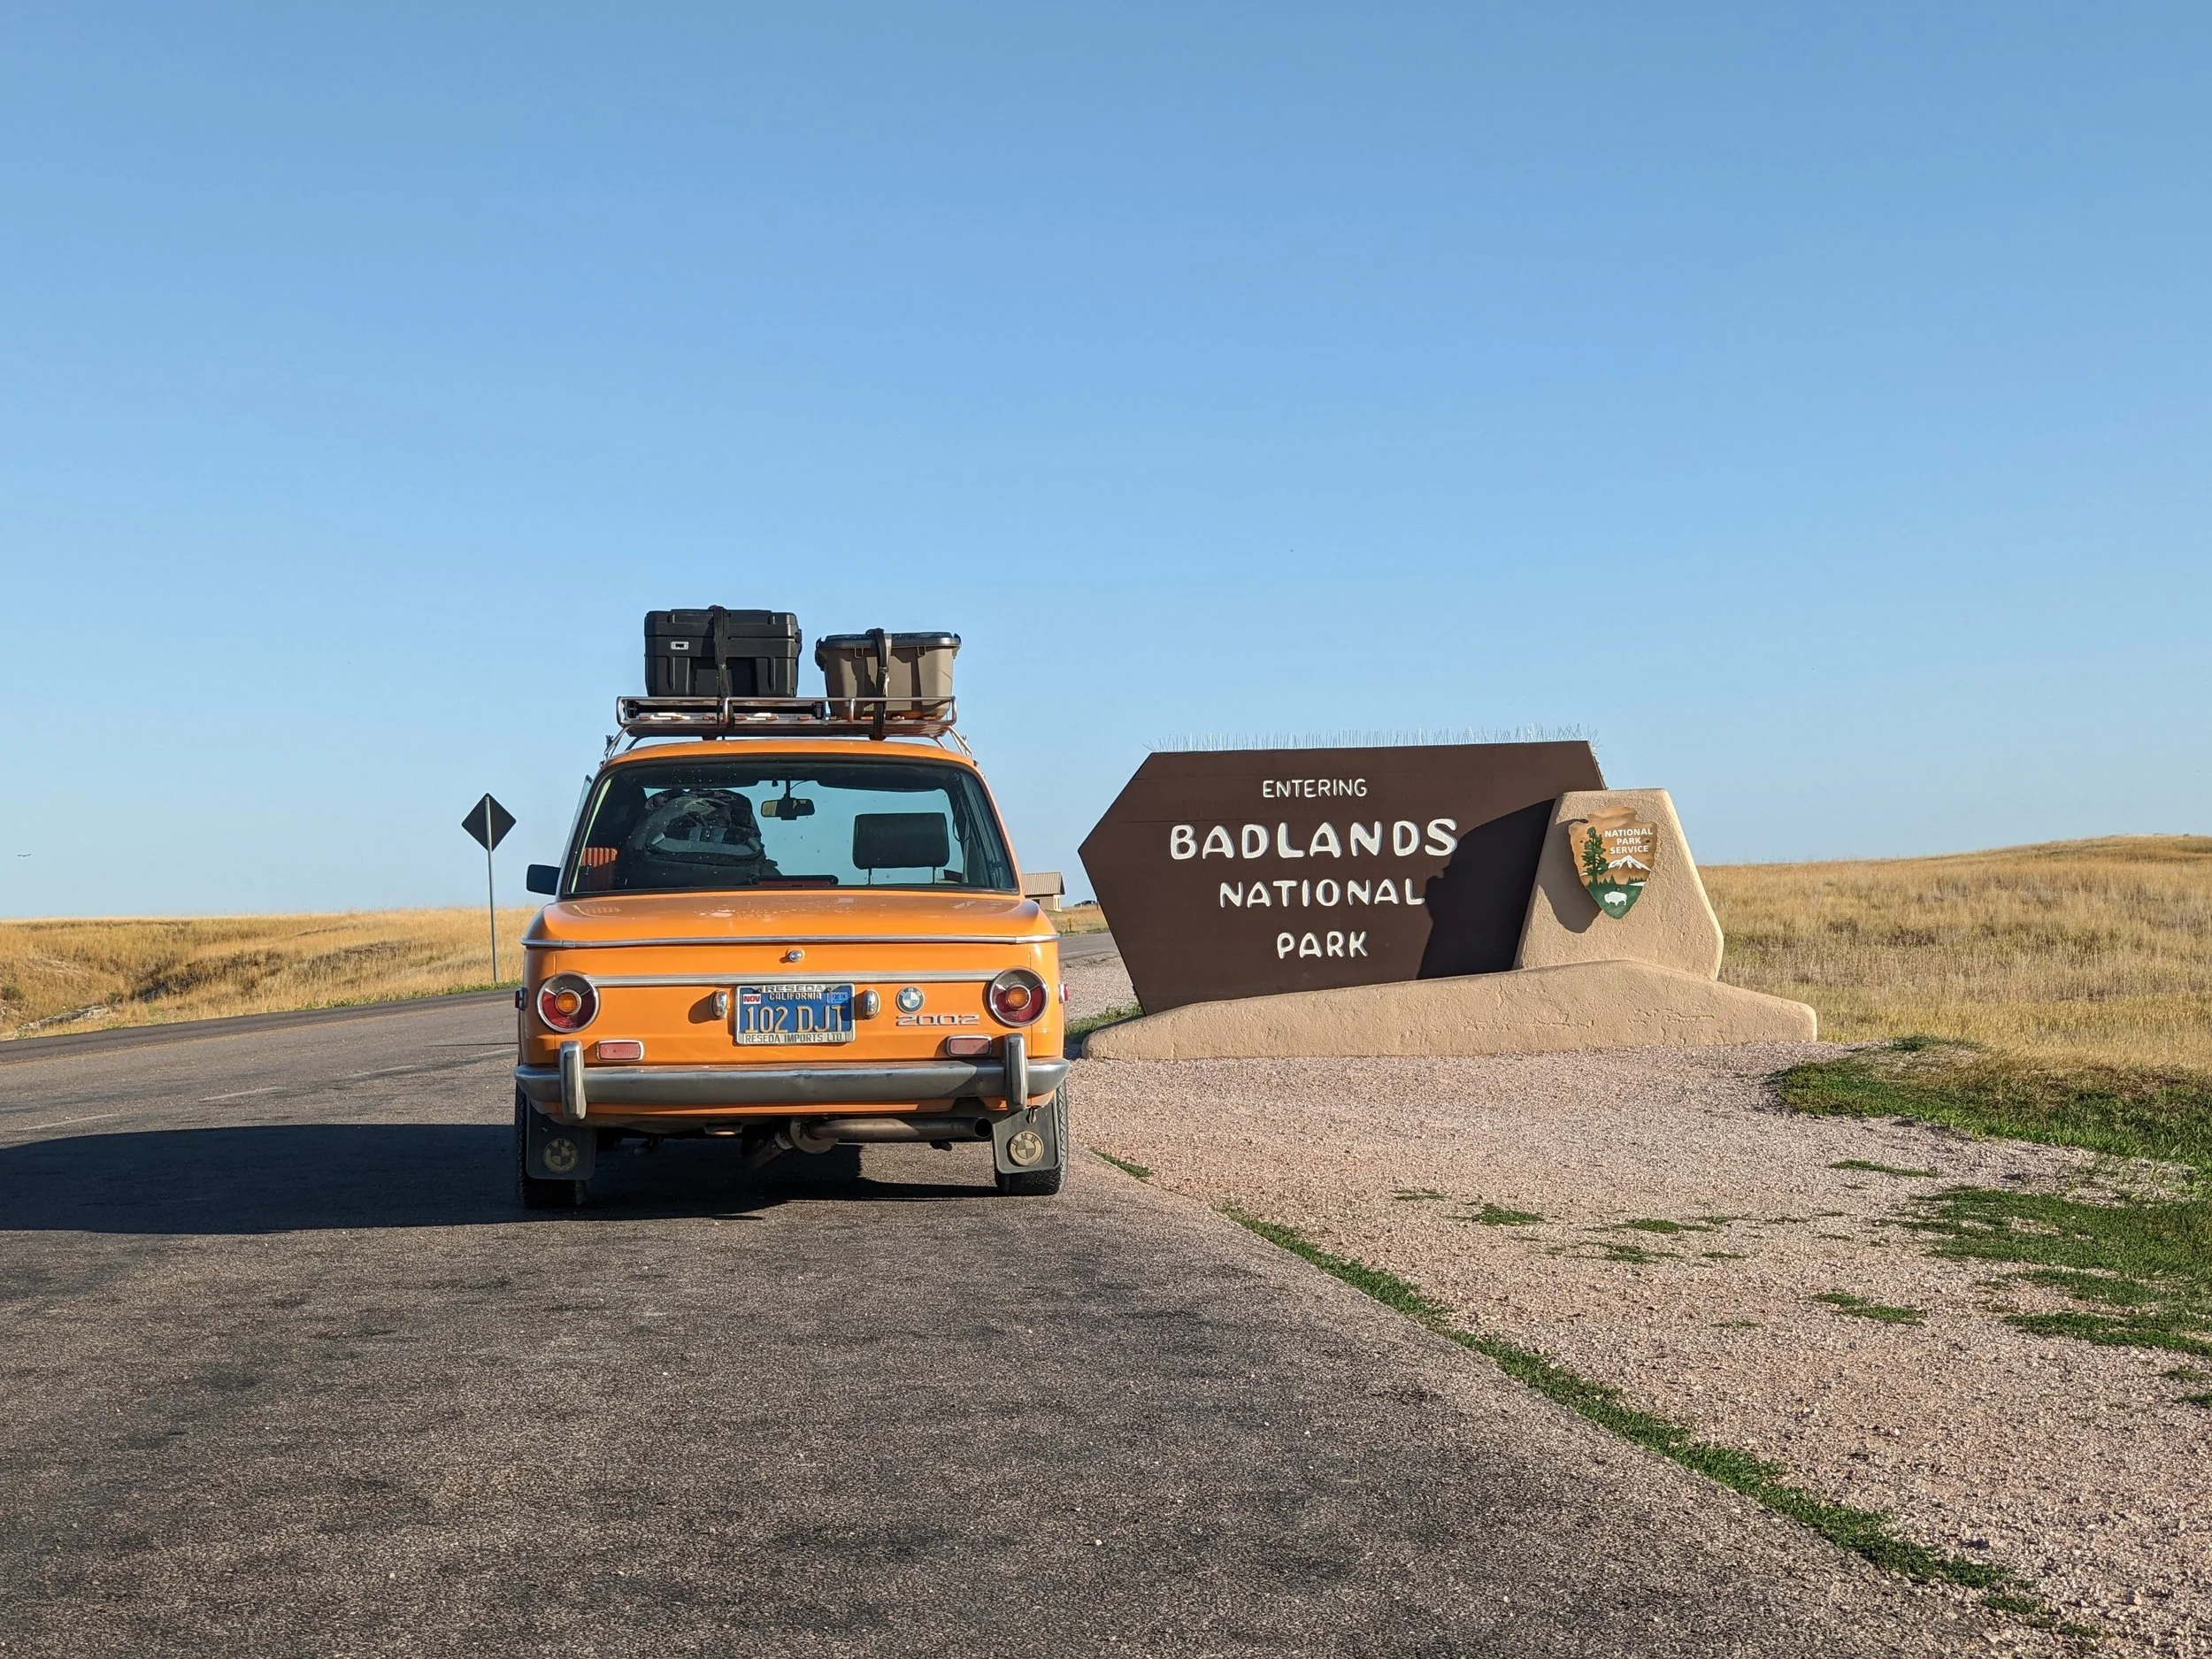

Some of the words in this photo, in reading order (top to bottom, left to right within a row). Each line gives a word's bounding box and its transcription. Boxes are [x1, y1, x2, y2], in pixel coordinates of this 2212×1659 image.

[1263, 778, 1368, 798] ENTERING
[1604, 827, 1653, 838] NATIONAL
[1169, 818, 1458, 860] BADLANDS
[1617, 837, 1641, 846] PARK
[1610, 845, 1649, 855] SERVICE
[1219, 878, 1425, 909] NATIONAL
[1276, 931, 1368, 960] PARK
[769, 992, 822, 1002] CALIFORNIA
[744, 1006, 788, 1033] 102
[796, 1004, 847, 1033] DJT
[896, 1014, 979, 1026] 2002
[745, 1033, 780, 1043] RESEDA
[784, 1033, 823, 1042] IMPORTS
